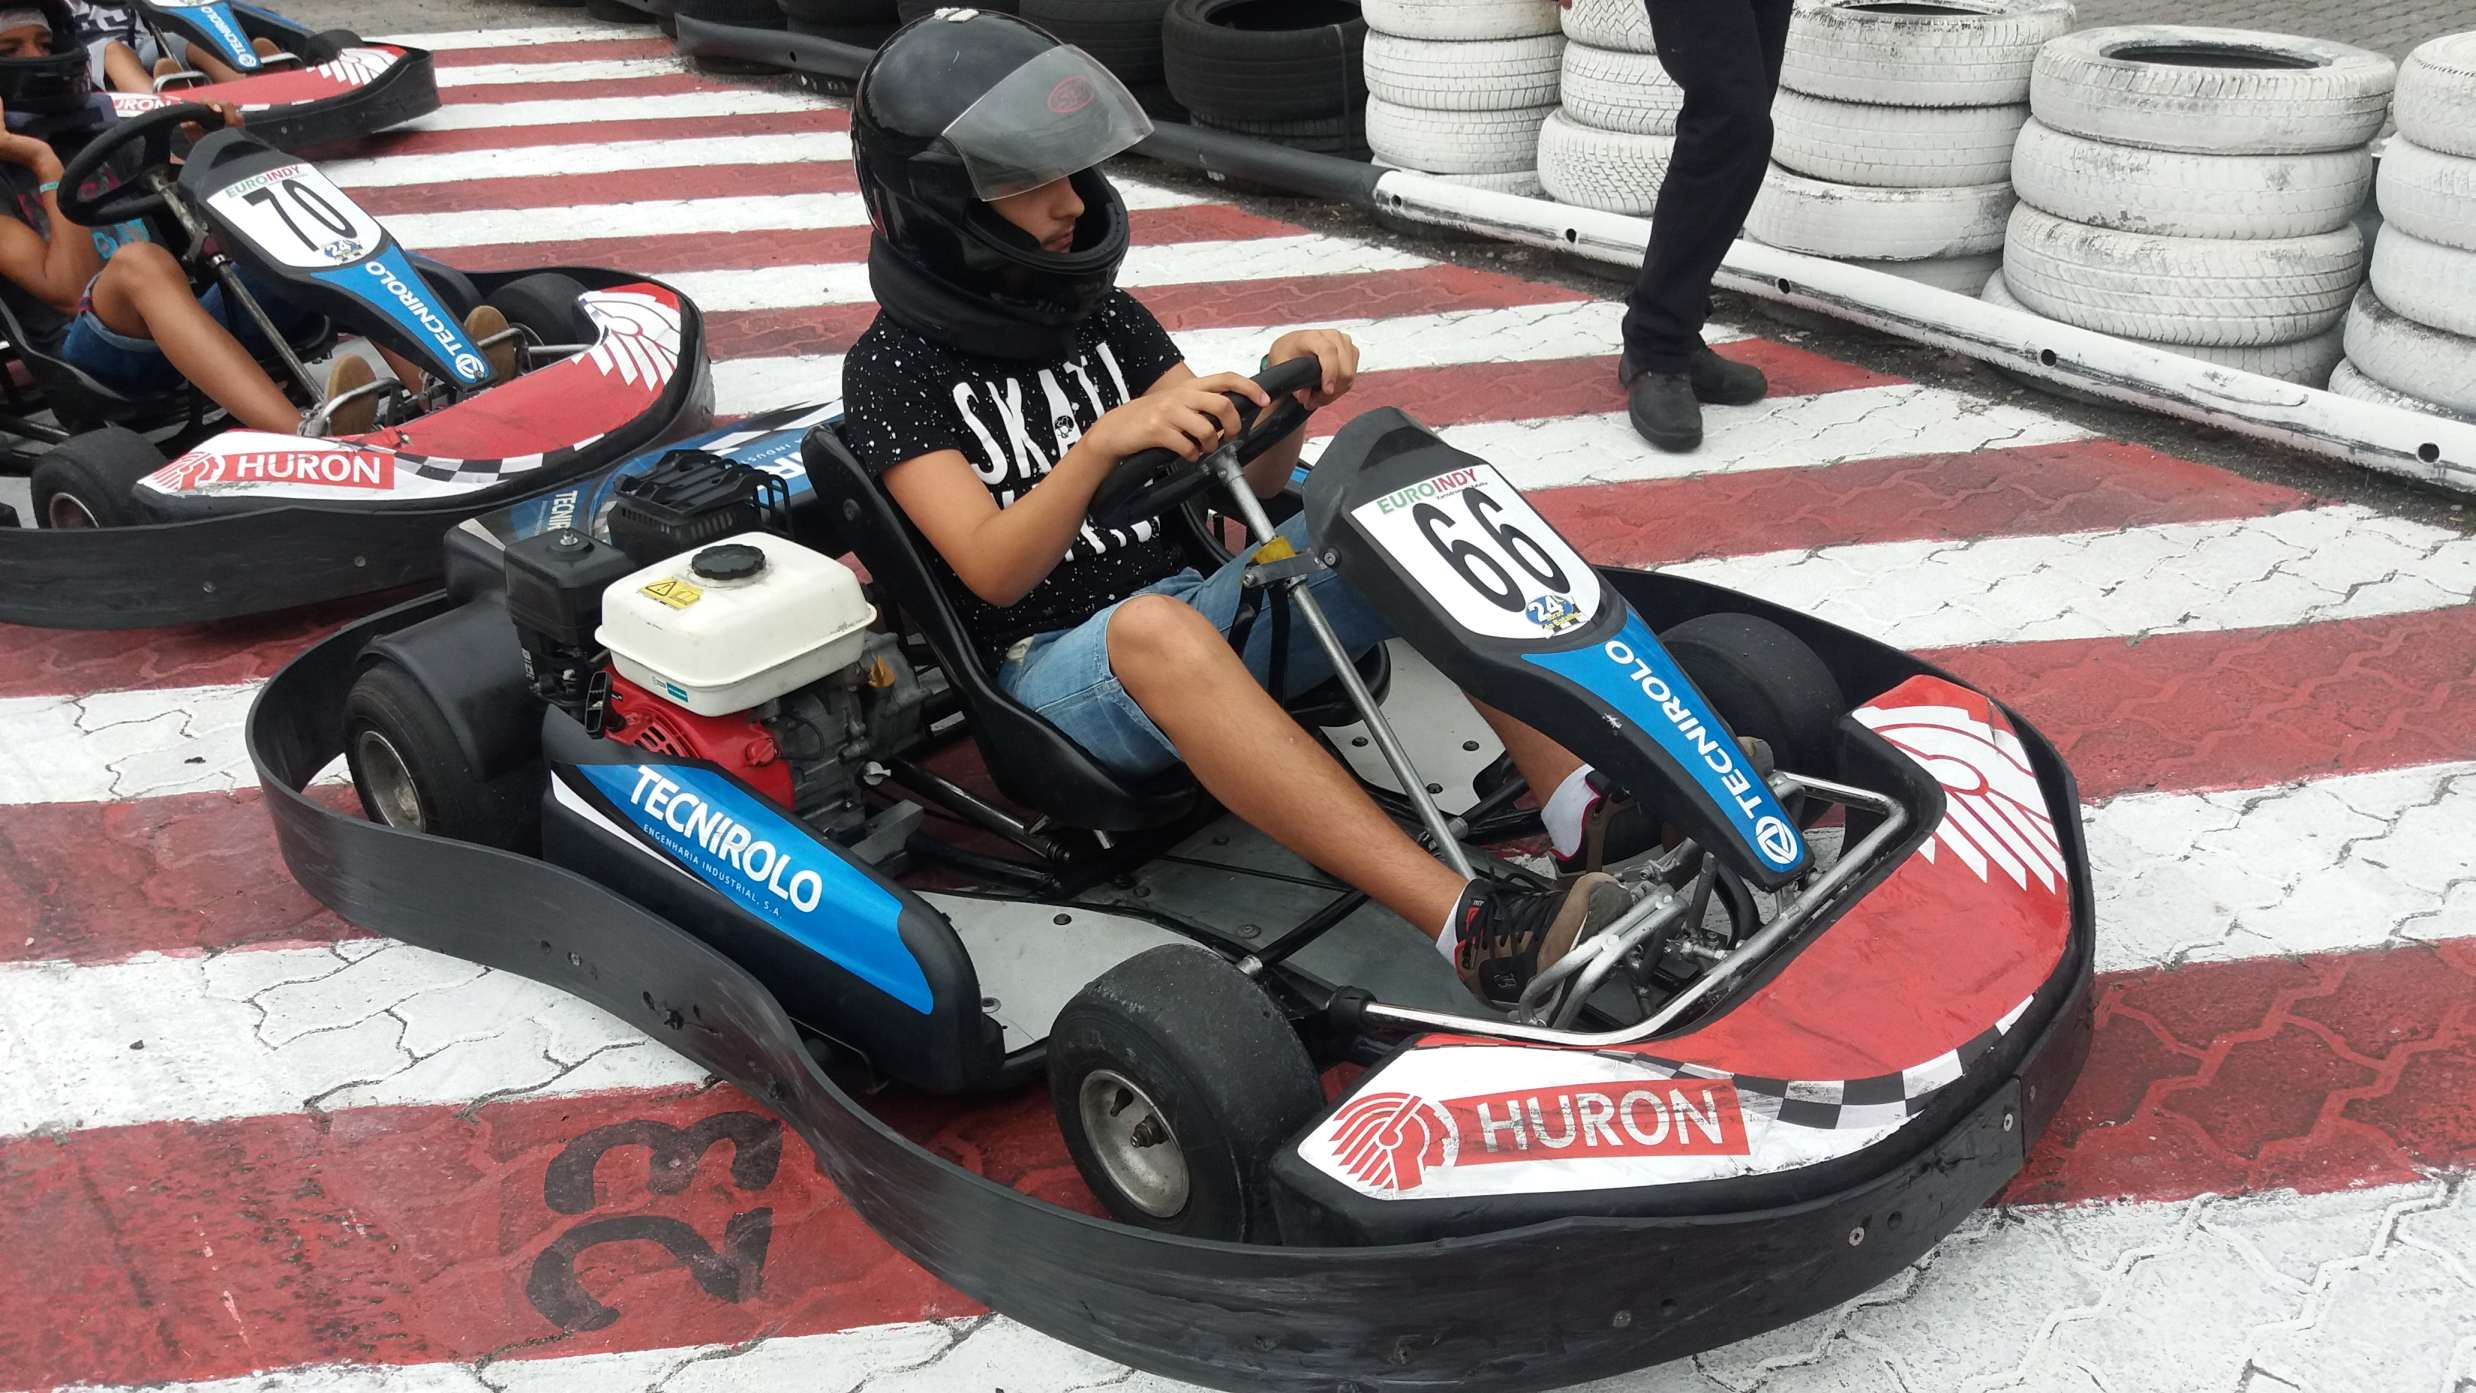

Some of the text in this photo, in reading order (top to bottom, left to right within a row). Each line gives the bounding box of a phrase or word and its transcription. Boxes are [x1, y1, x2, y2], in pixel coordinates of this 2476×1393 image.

[112, 98, 172, 111] URON
[225, 165, 301, 198] EUROINDY
[242, 179, 357, 252] 70
[365, 261, 463, 356] TECNIROLO
[236, 454, 381, 484] HURON
[1376, 468, 1477, 515] EUROINDY
[547, 490, 578, 531] TECNIR
[1412, 487, 1570, 613] 66
[1604, 639, 1761, 819] TECNIROLO
[630, 765, 823, 913] TECNIROLO
[643, 824, 699, 864] ENGENHARIA
[1478, 1089, 1724, 1153] HURON
[526, 1110, 782, 1331] 23
